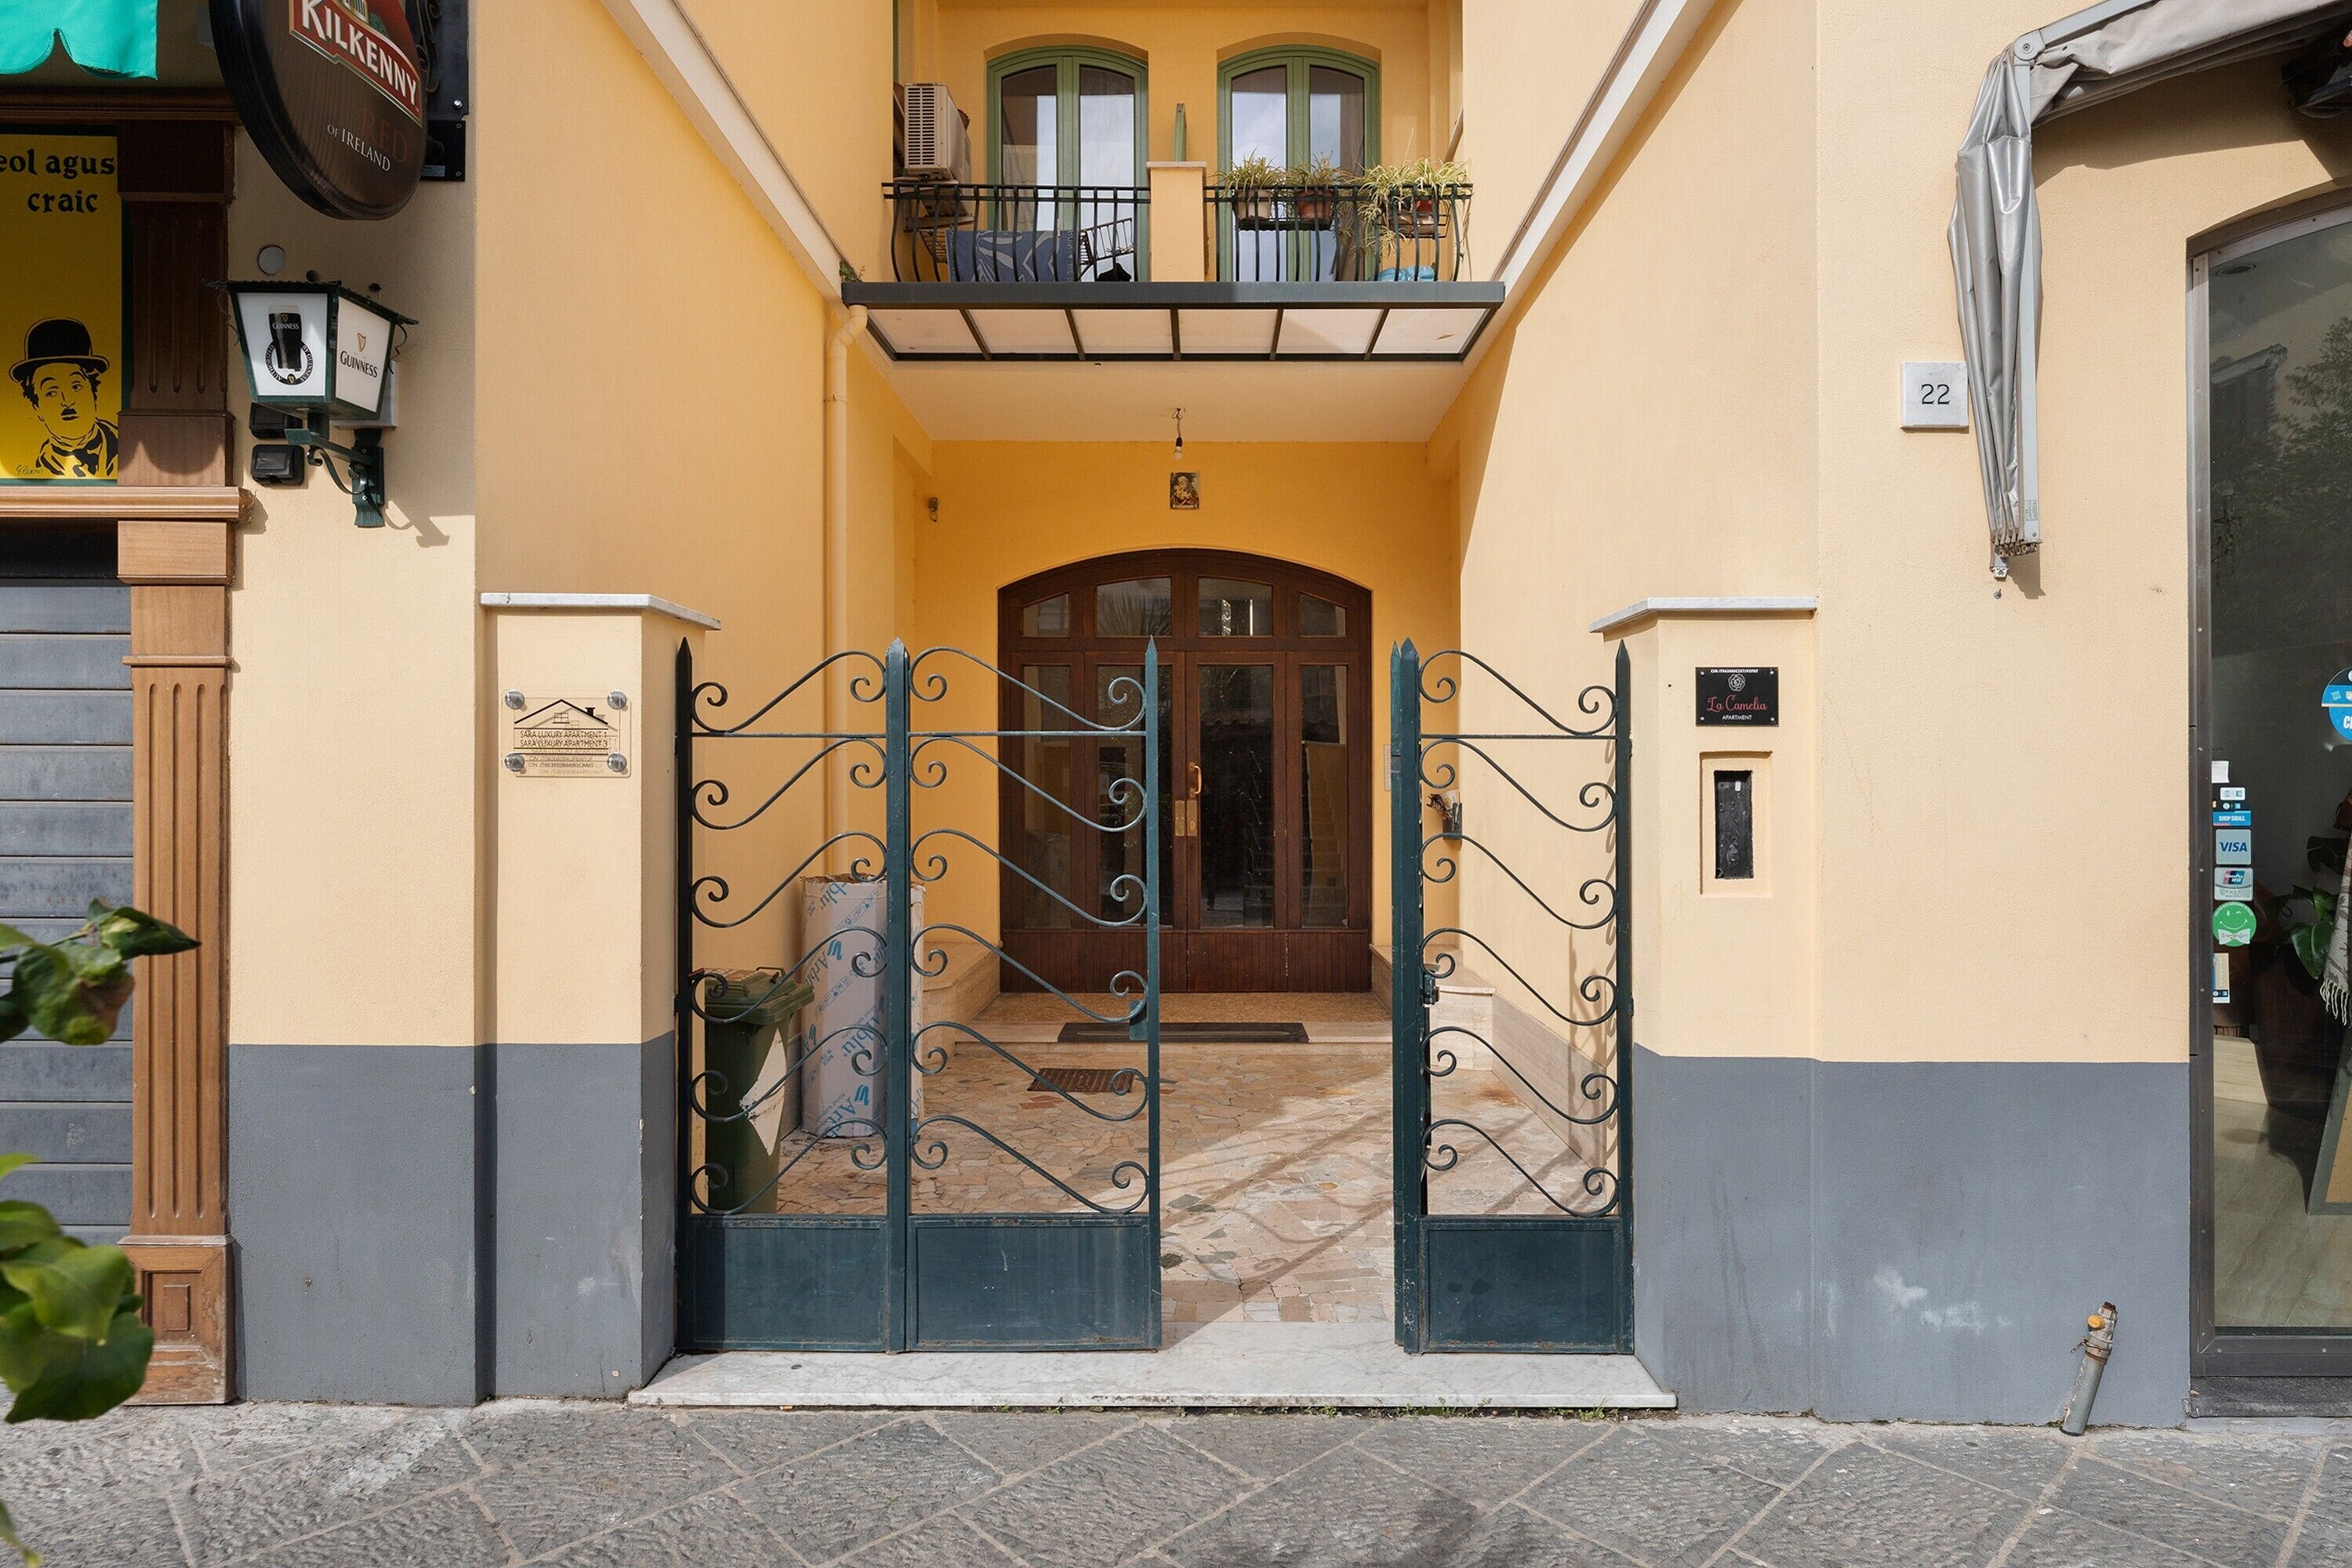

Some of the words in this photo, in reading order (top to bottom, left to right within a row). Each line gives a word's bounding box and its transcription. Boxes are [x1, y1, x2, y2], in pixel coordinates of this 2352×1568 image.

[302, 0, 416, 106] KILKENNY
[363, 107, 408, 162] RED
[327, 124, 339, 137] OF
[342, 128, 391, 172] IRELAND
[45, 154, 115, 180] agus
[27, 189, 98, 214] craic
[339, 350, 378, 378] GUINNESS
[1920, 383, 1951, 405] 22
[1706, 695, 1724, 713] La
[1725, 694, 1768, 711] Camelia
[539, 739, 564, 748] LUXURY
[564, 739, 602, 748] APARTMENT
[2219, 841, 2248, 852] VISA
